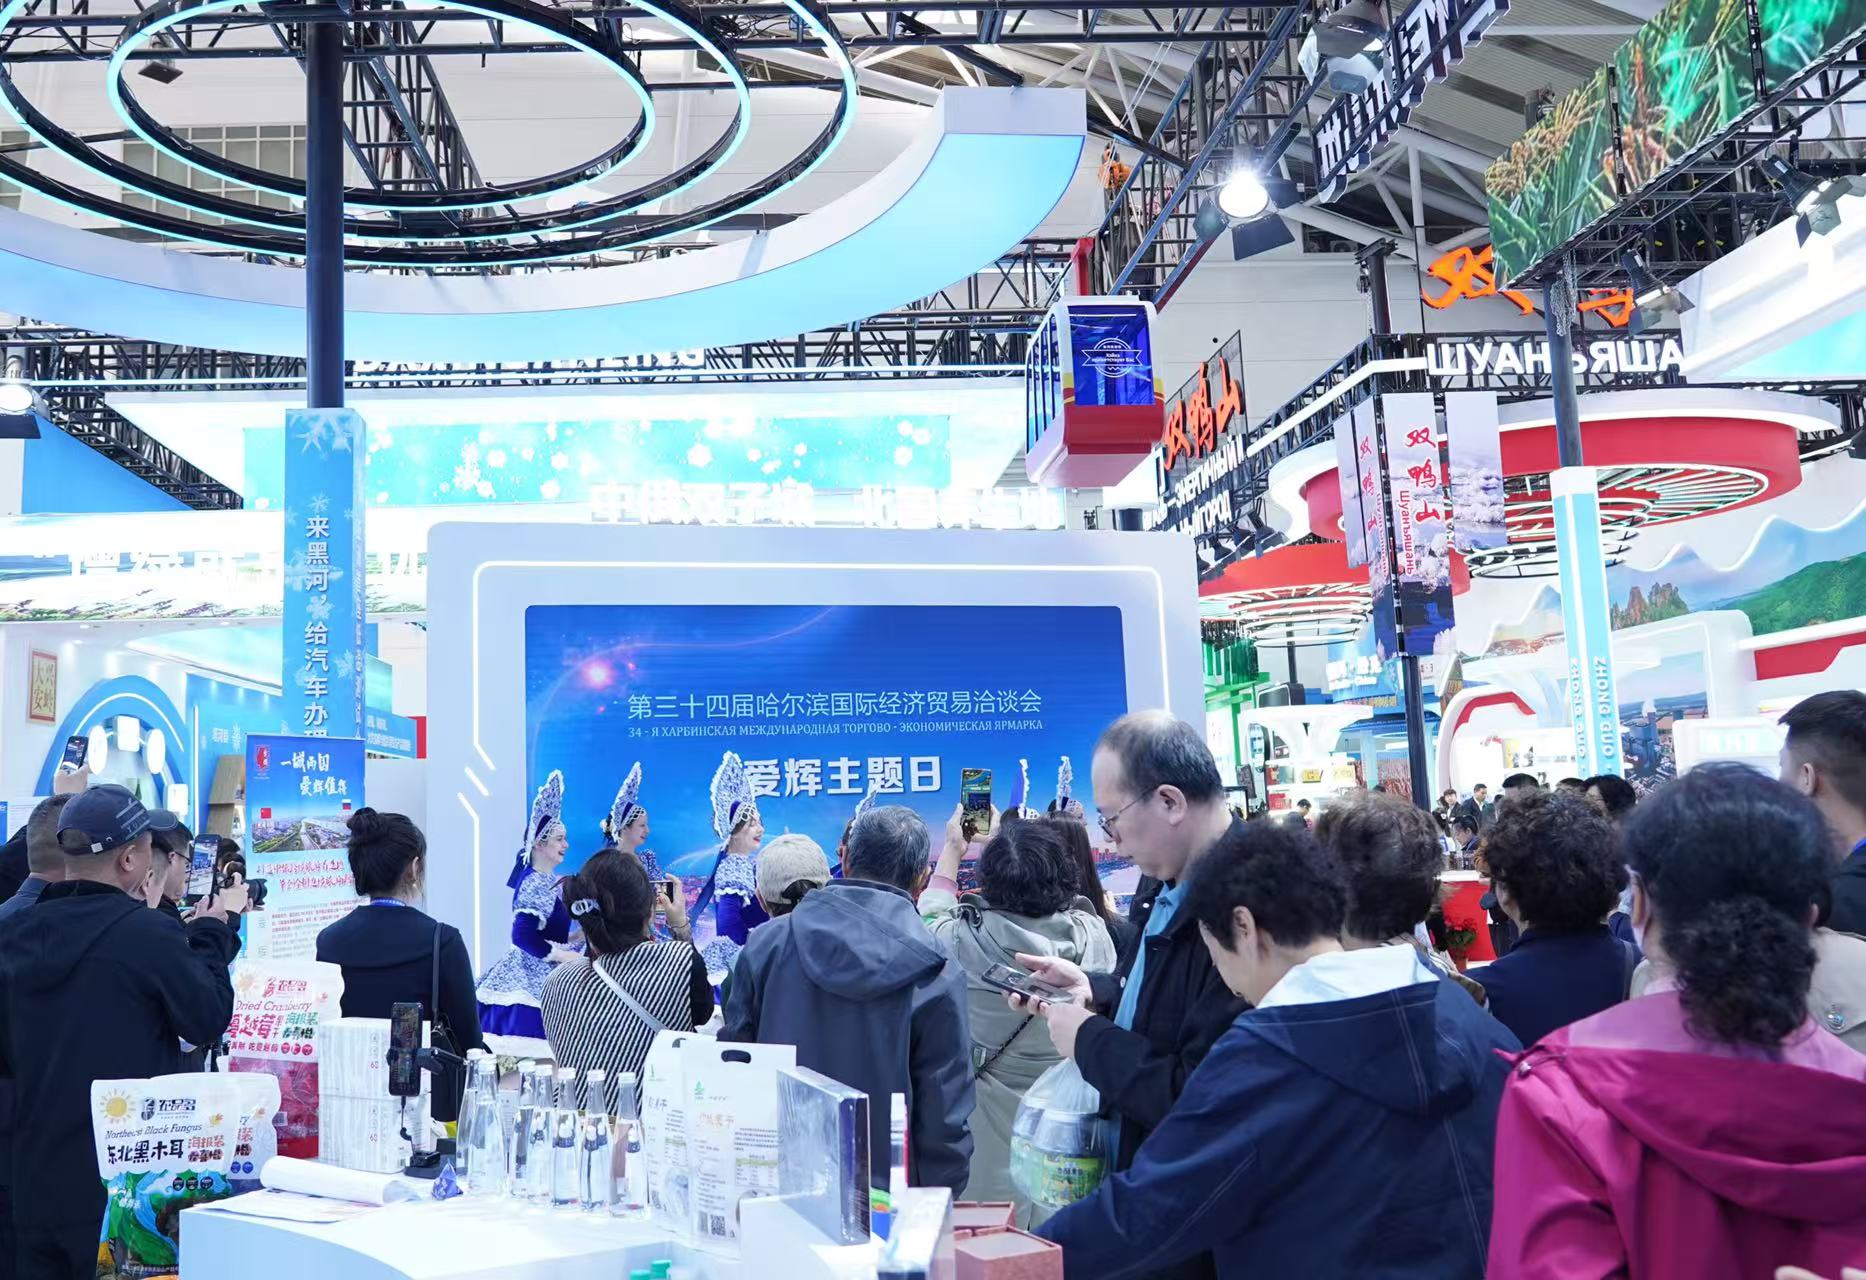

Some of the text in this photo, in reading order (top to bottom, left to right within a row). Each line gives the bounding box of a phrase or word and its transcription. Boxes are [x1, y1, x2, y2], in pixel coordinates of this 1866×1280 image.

[1406, 427, 1441, 524] 双鸭山
[628, 688, 1042, 719] 第三十四届哈尔滨国际经济贸易洽谈会
[628, 727, 642, 738] 34
[651, 726, 659, 737] Я
[661, 725, 736, 737] ХАРБИНСКАЯ
[739, 723, 839, 736] МЕЖДУНАРОДНАЯ
[843, 722, 891, 734] ТОРГОВО
[899, 721, 992, 733] ЭКОНОМИЧЕСКАЯ
[994, 719, 1043, 731] ЯРМАРКА
[744, 756, 942, 797] 爱辉主题日
[144, 1124, 169, 1136] Black
[169, 1122, 203, 1135] Fungus
[106, 1138, 185, 1165] 东北黑木耳
